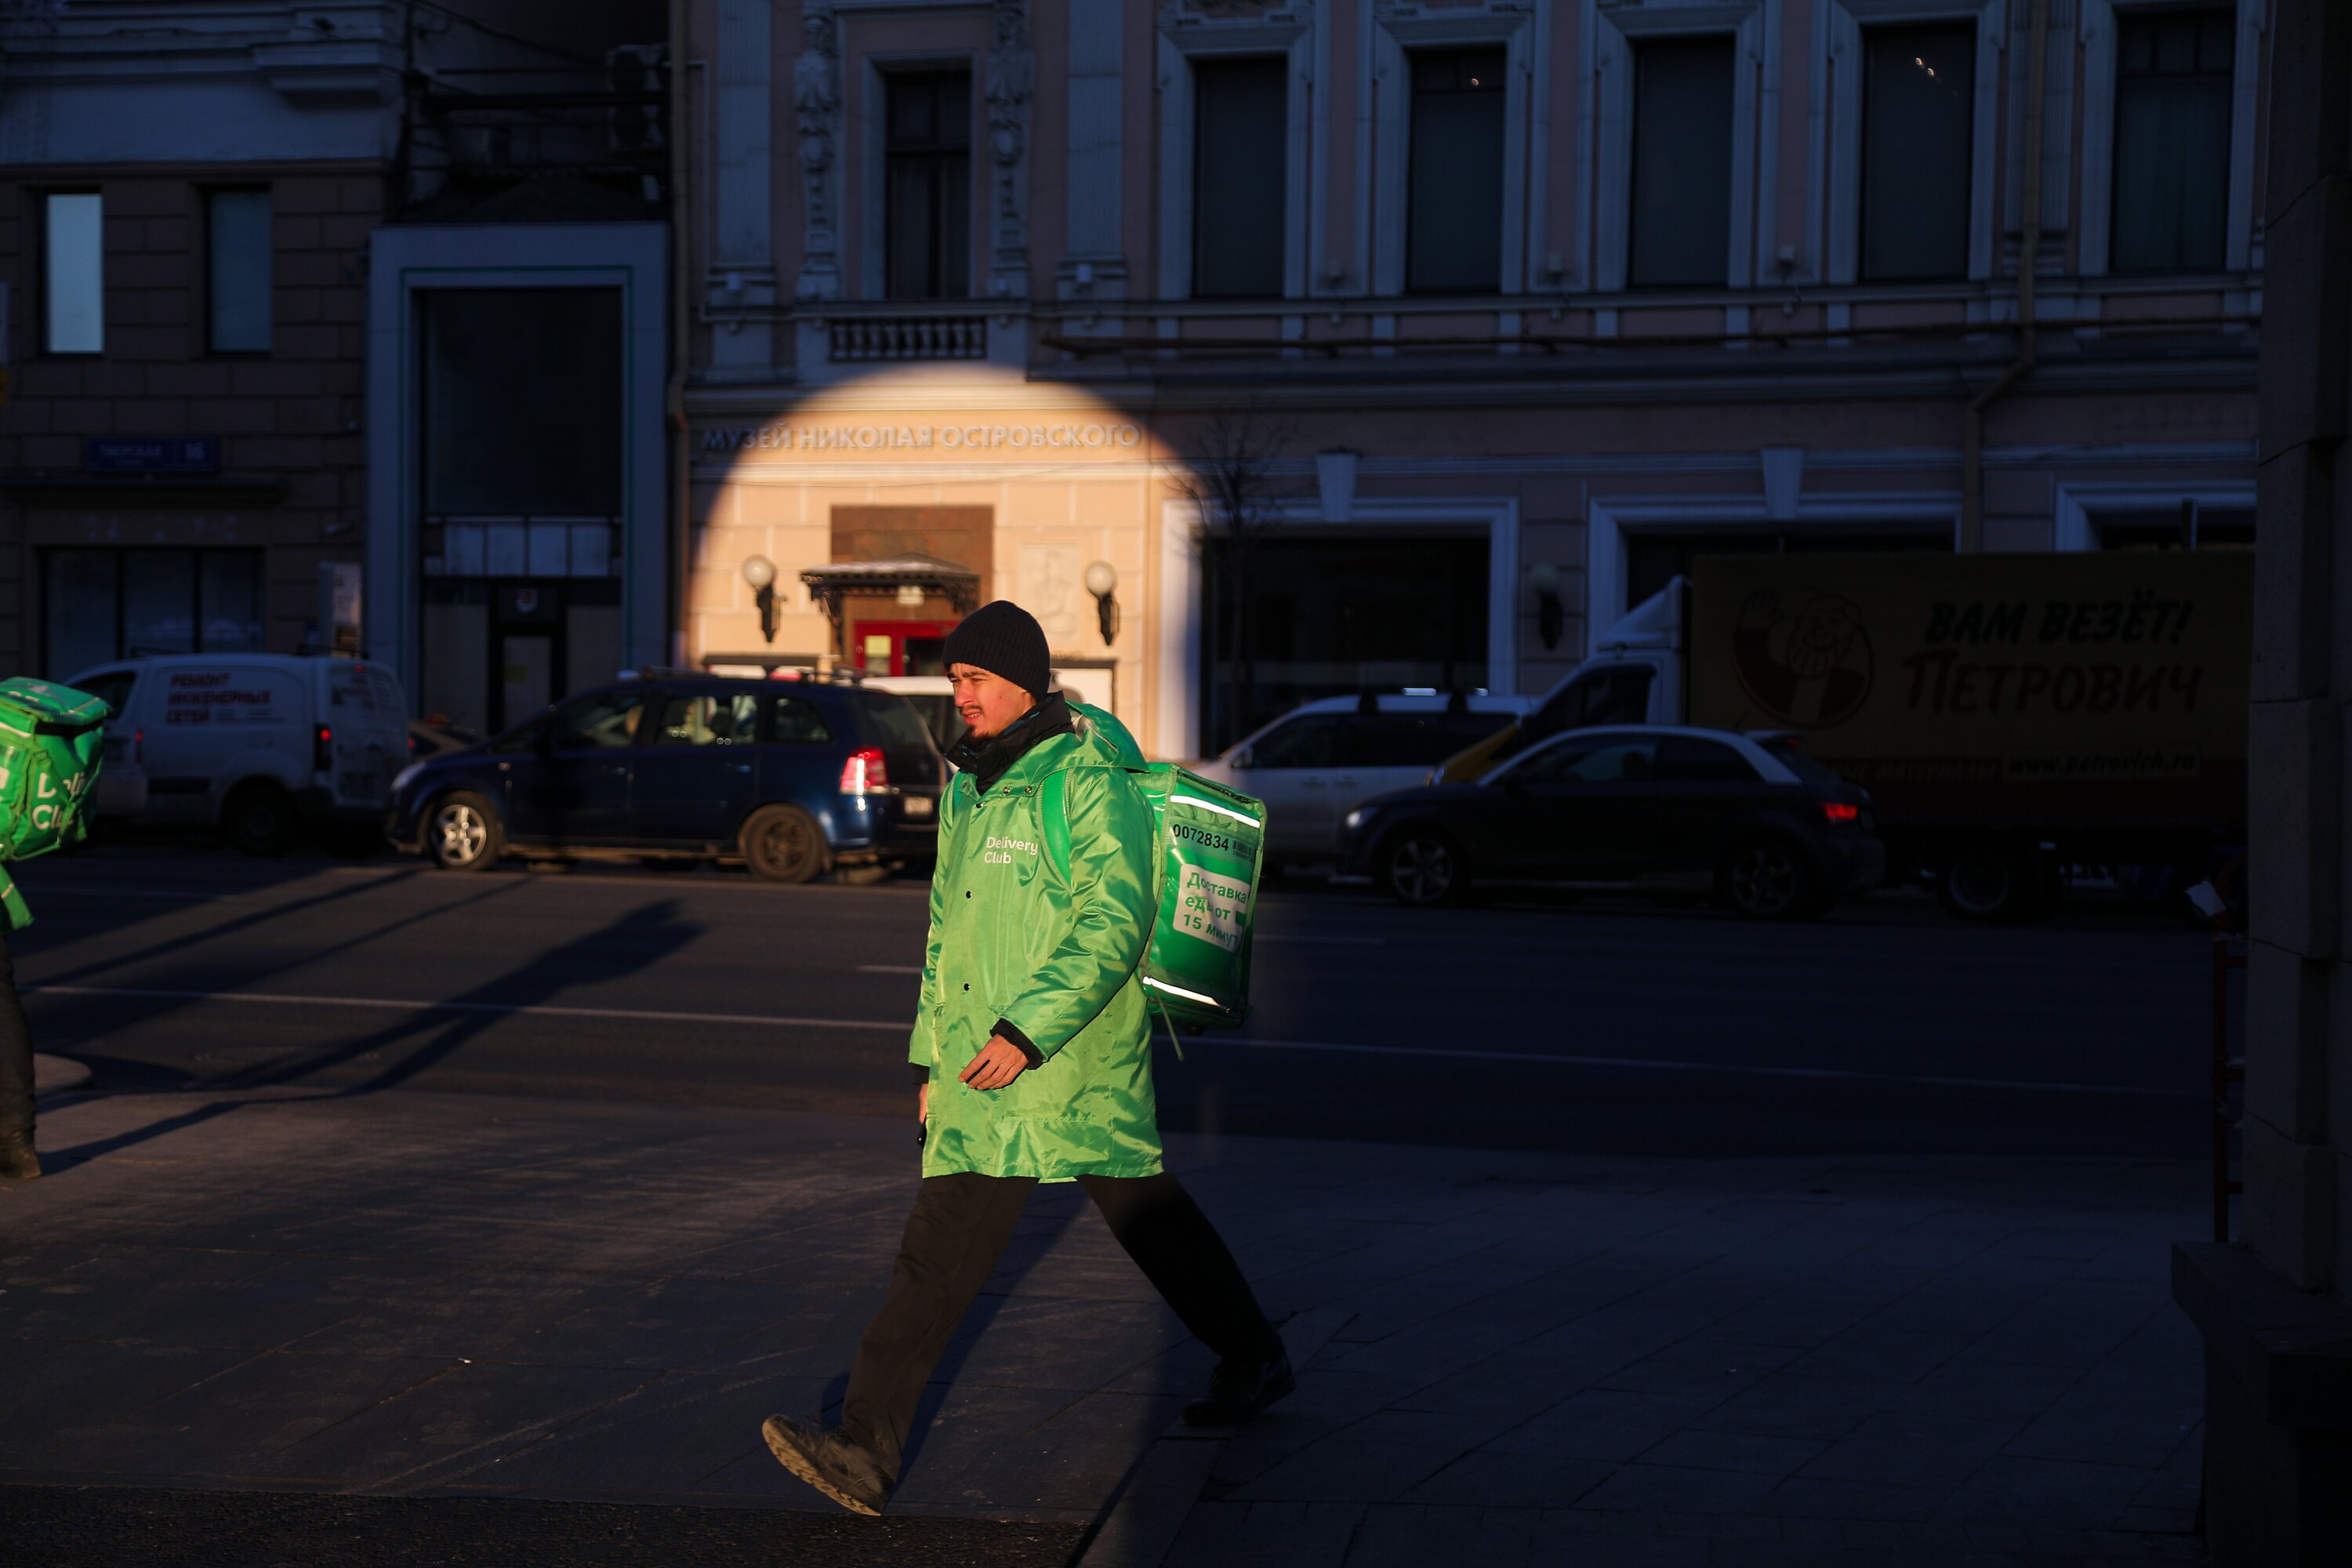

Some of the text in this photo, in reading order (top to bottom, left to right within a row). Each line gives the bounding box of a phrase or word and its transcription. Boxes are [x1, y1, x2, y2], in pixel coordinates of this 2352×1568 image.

[703, 422, 1141, 449] МУЗЕЙ НИКОЛАЯ ОСТРОВСКОГО
[1926, 590, 2195, 644] ВАМ ВЕЗЁТ!
[170, 672, 230, 686] РЕМОНТ
[168, 689, 272, 704] ИНЖЕНЕРНЫХ
[2009, 750, 2195, 776] www.petrovich.ru
[986, 837, 1038, 856] Delivery
[1172, 823, 1229, 851] 0072834
[984, 851, 1012, 864] Club
[1186, 872, 1247, 904] Доставка
[1185, 895, 1232, 920] еды от
[1184, 913, 1240, 947] 15 минут
